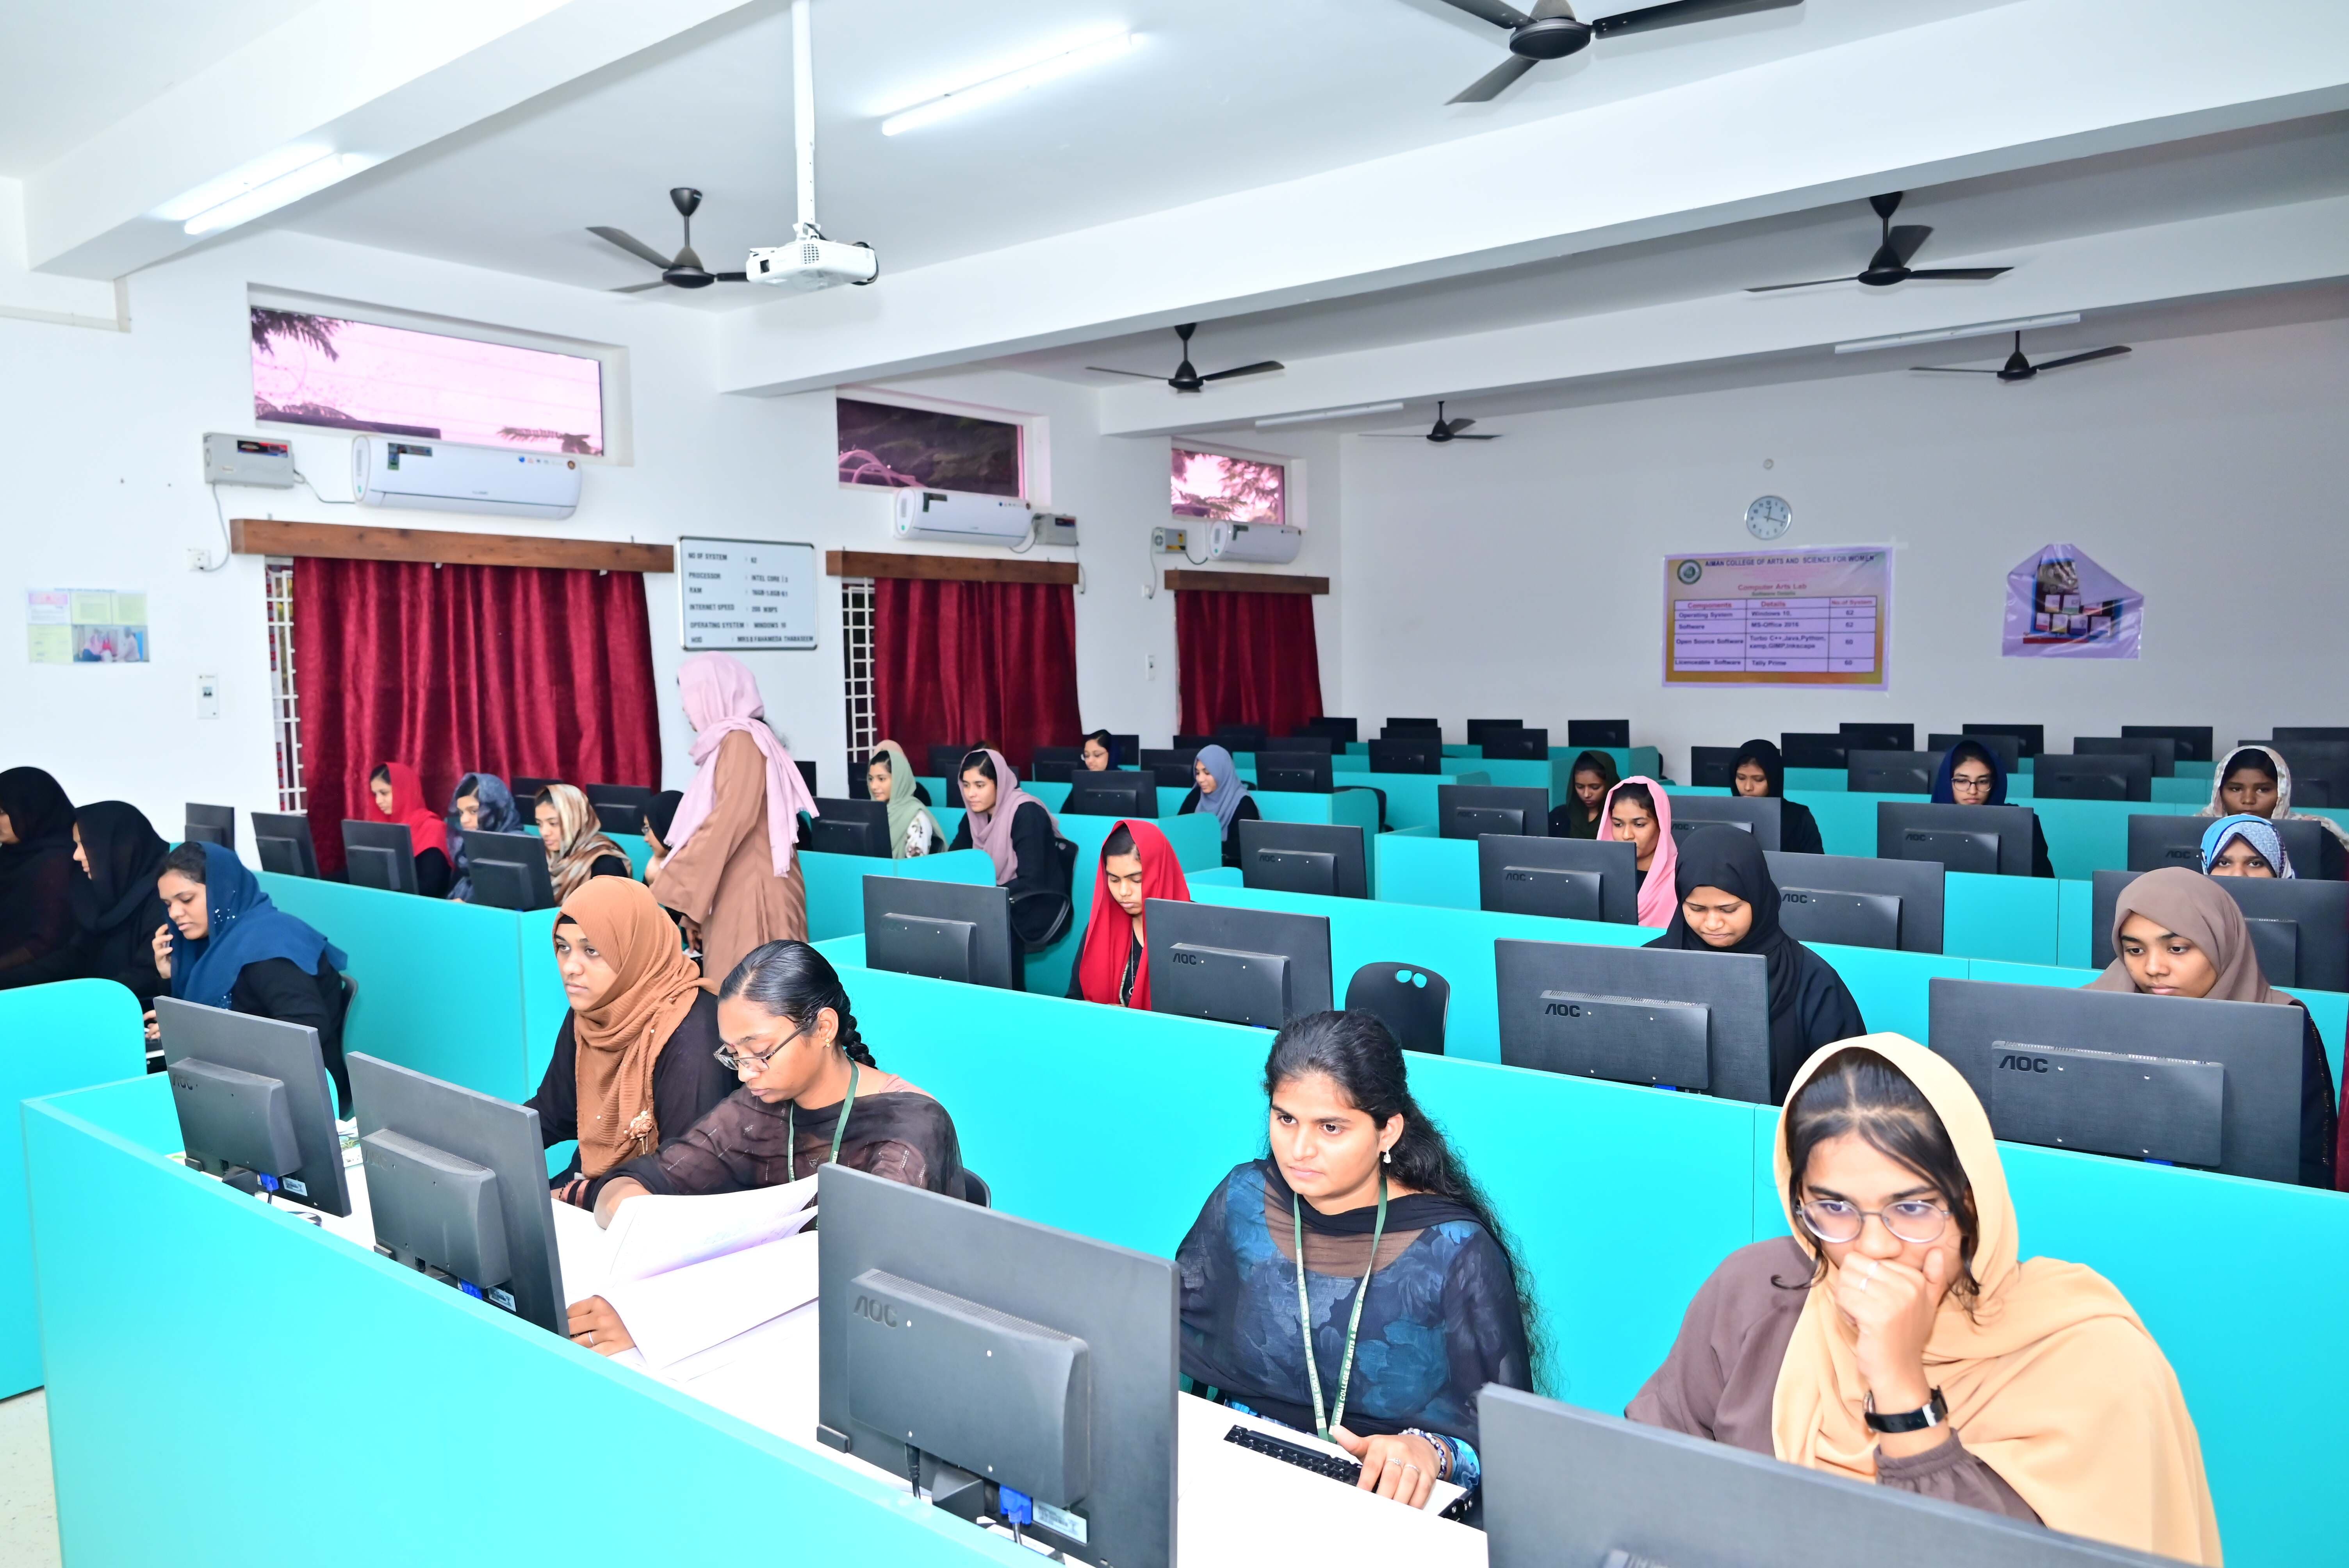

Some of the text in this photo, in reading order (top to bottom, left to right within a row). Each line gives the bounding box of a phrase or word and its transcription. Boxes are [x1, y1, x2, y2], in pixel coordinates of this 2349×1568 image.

[2165, 851, 2191, 859] AOC
[1506, 873, 1526, 881] AOC
[1782, 894, 1807, 903] AOC
[1173, 953, 1196, 965] AOC
[1545, 1003, 1581, 1017] AOC
[1999, 1055, 2048, 1073] AOC
[852, 1295, 897, 1327] AOC
[1351, 1302, 1362, 1332] SCIENCE
[1306, 1349, 1312, 1358] OF
[1347, 1340, 1355, 1359] ARTS
[1345, 1359, 1352, 1369] OF
[1308, 1359, 1319, 1392] COLLEGE
[1339, 1370, 1350, 1401] COLLEGE
[1334, 1402, 1344, 1425] AIMAN
